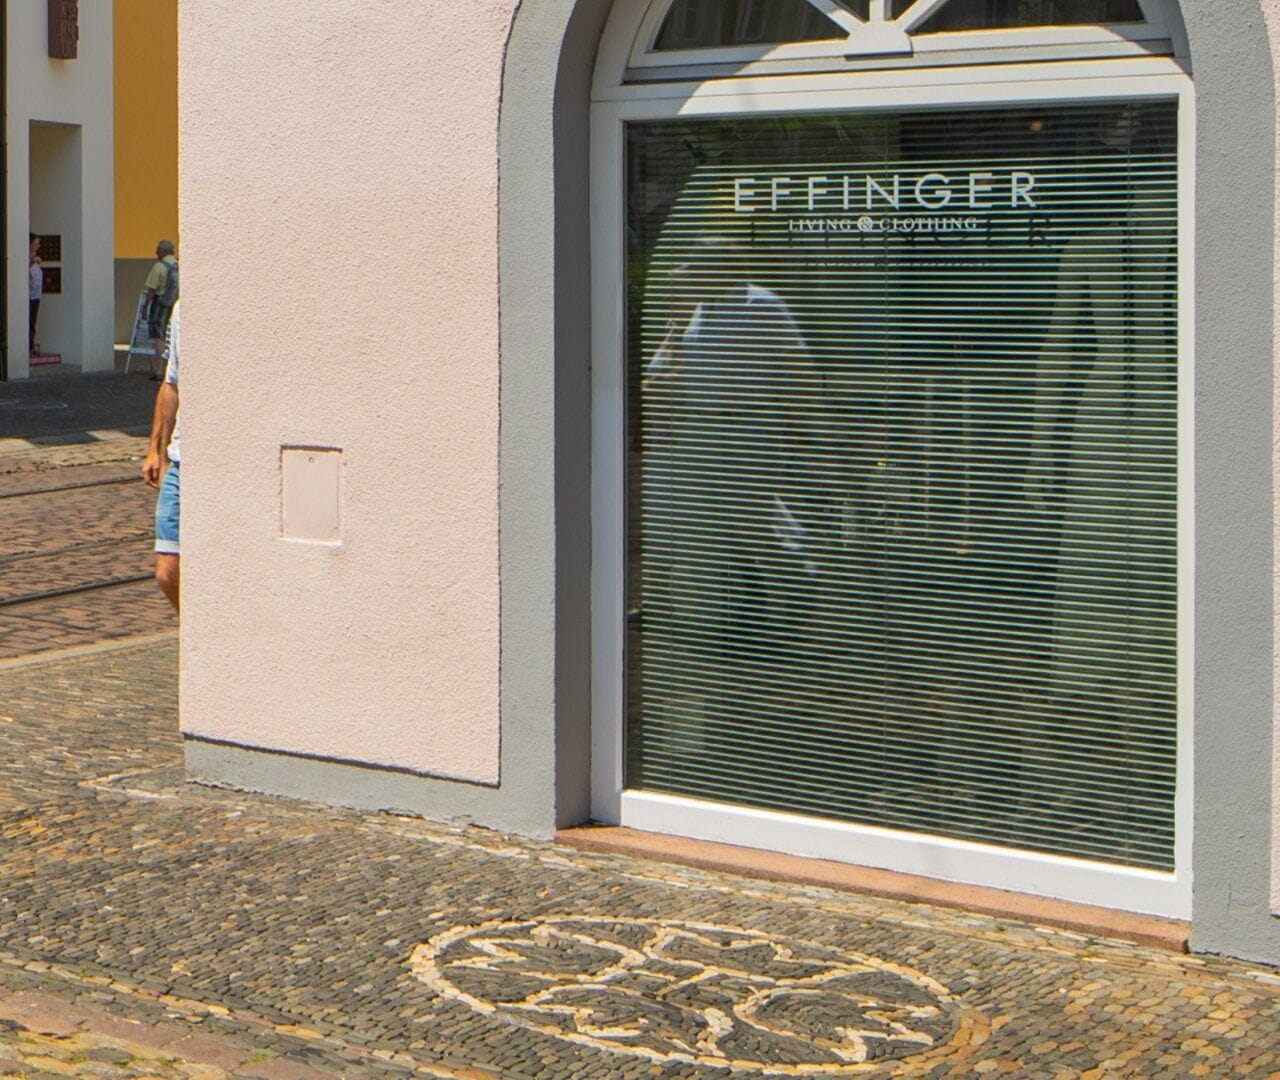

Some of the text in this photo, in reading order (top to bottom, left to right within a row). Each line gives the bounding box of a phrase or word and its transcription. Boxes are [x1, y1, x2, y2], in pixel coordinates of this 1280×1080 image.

[734, 172, 1038, 212] EFFINGER
[788, 219, 852, 233] LIVING
[879, 217, 978, 232] CLOTHING
